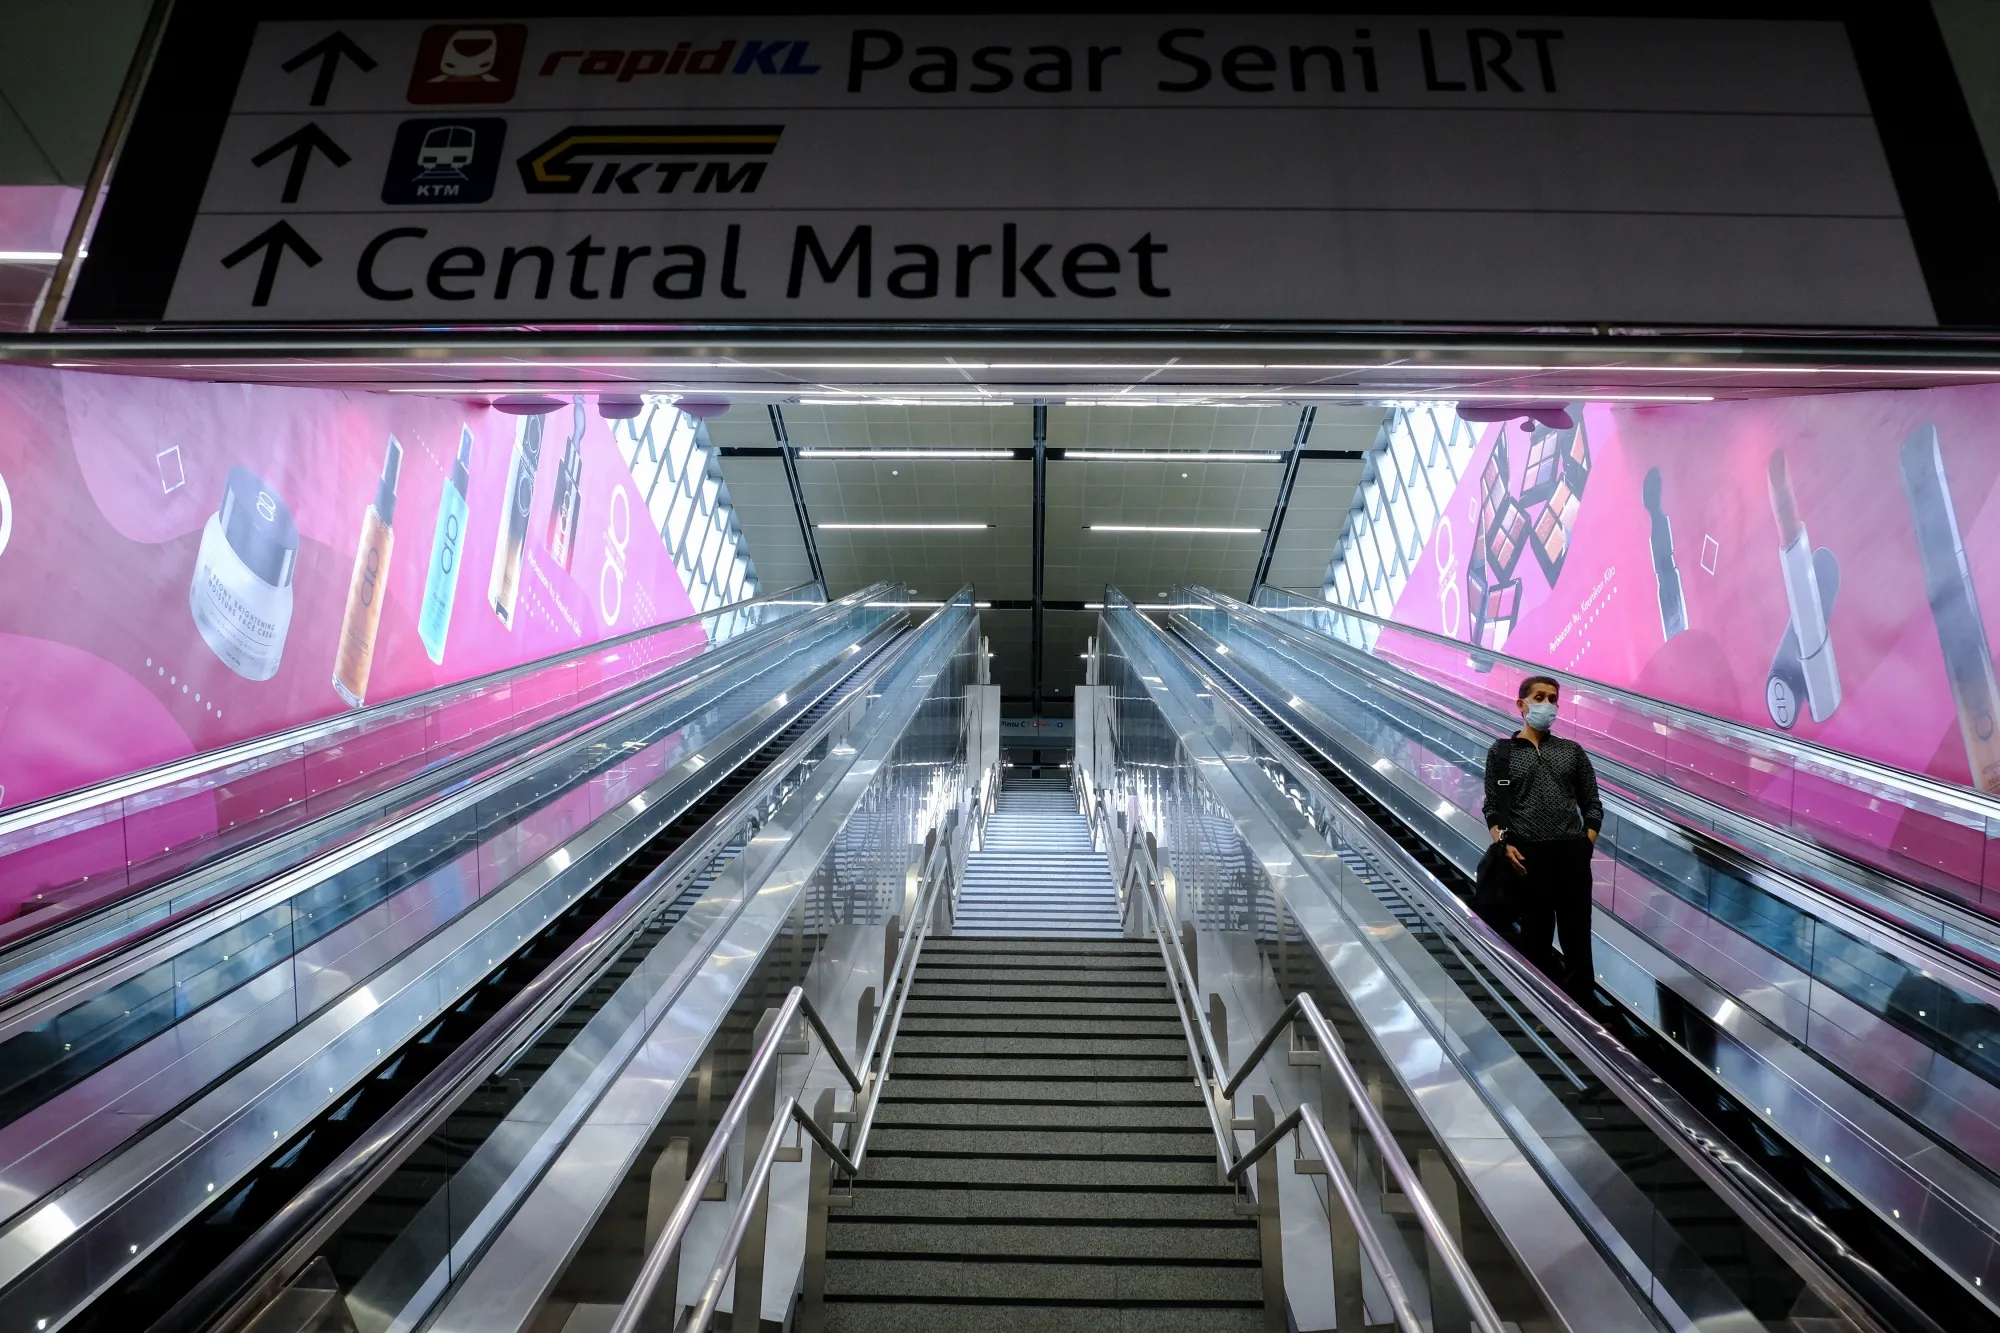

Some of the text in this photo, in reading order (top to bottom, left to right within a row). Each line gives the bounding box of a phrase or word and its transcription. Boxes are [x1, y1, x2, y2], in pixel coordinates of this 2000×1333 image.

[848, 29, 1121, 94] Pasar
[1157, 26, 1379, 93] Seni
[1418, 27, 1564, 92] LRT
[417, 184, 460, 197] KTM
[592, 162, 768, 195] KTM
[356, 222, 1172, 302] Central Market
[208, 578, 236, 617] MOISTURE
[239, 614, 255, 632] FACE
[213, 574, 276, 631] PEONY BRIGHTENING
